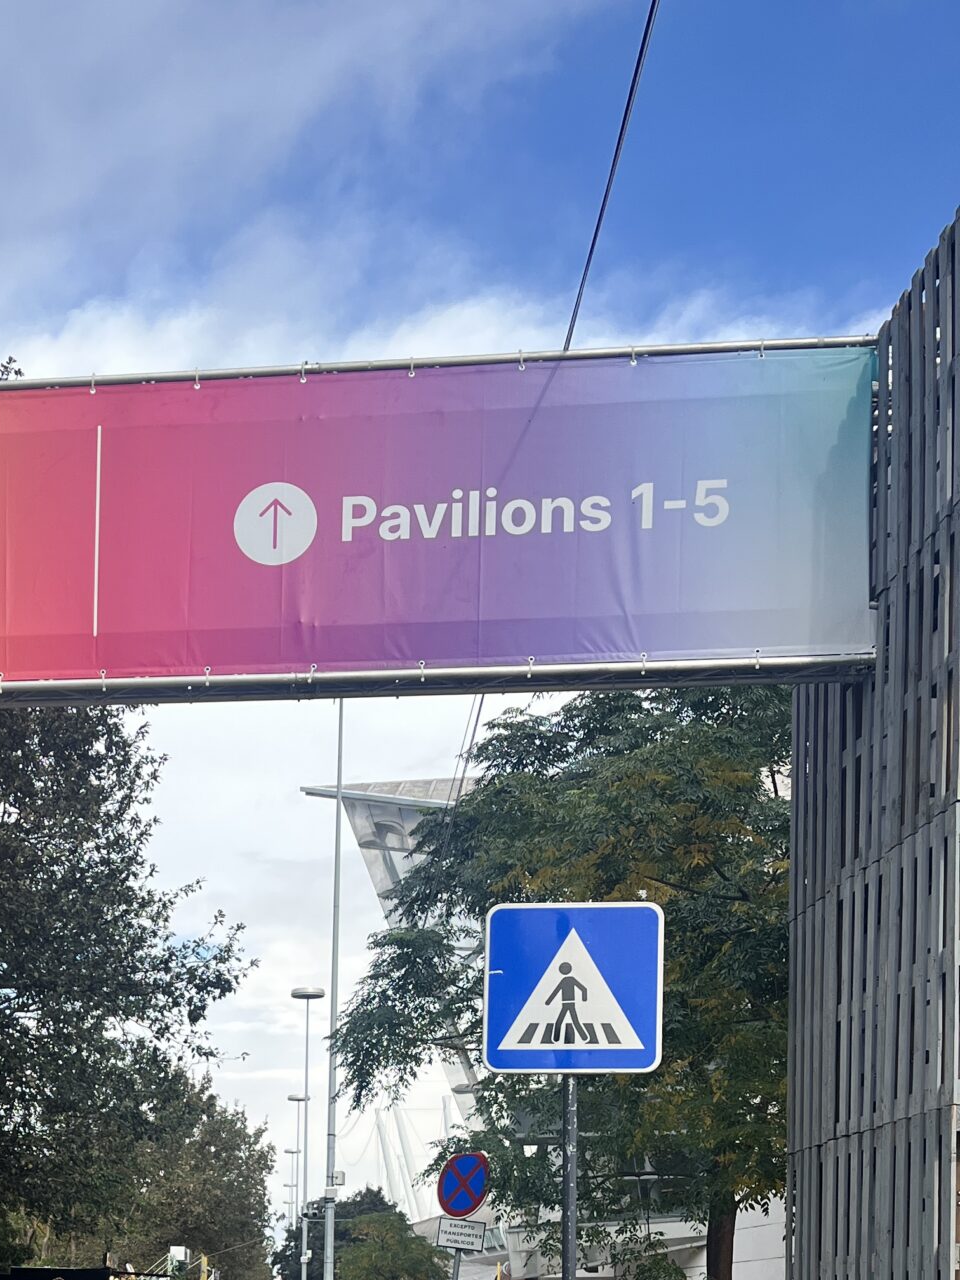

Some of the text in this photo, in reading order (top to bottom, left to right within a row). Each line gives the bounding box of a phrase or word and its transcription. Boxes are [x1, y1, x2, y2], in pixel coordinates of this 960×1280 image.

[341, 479, 730, 542] Pavilions 1-5
[440, 1230, 482, 1239] TRANSPORTES
[446, 1238, 475, 1246] PÚBLICOS
